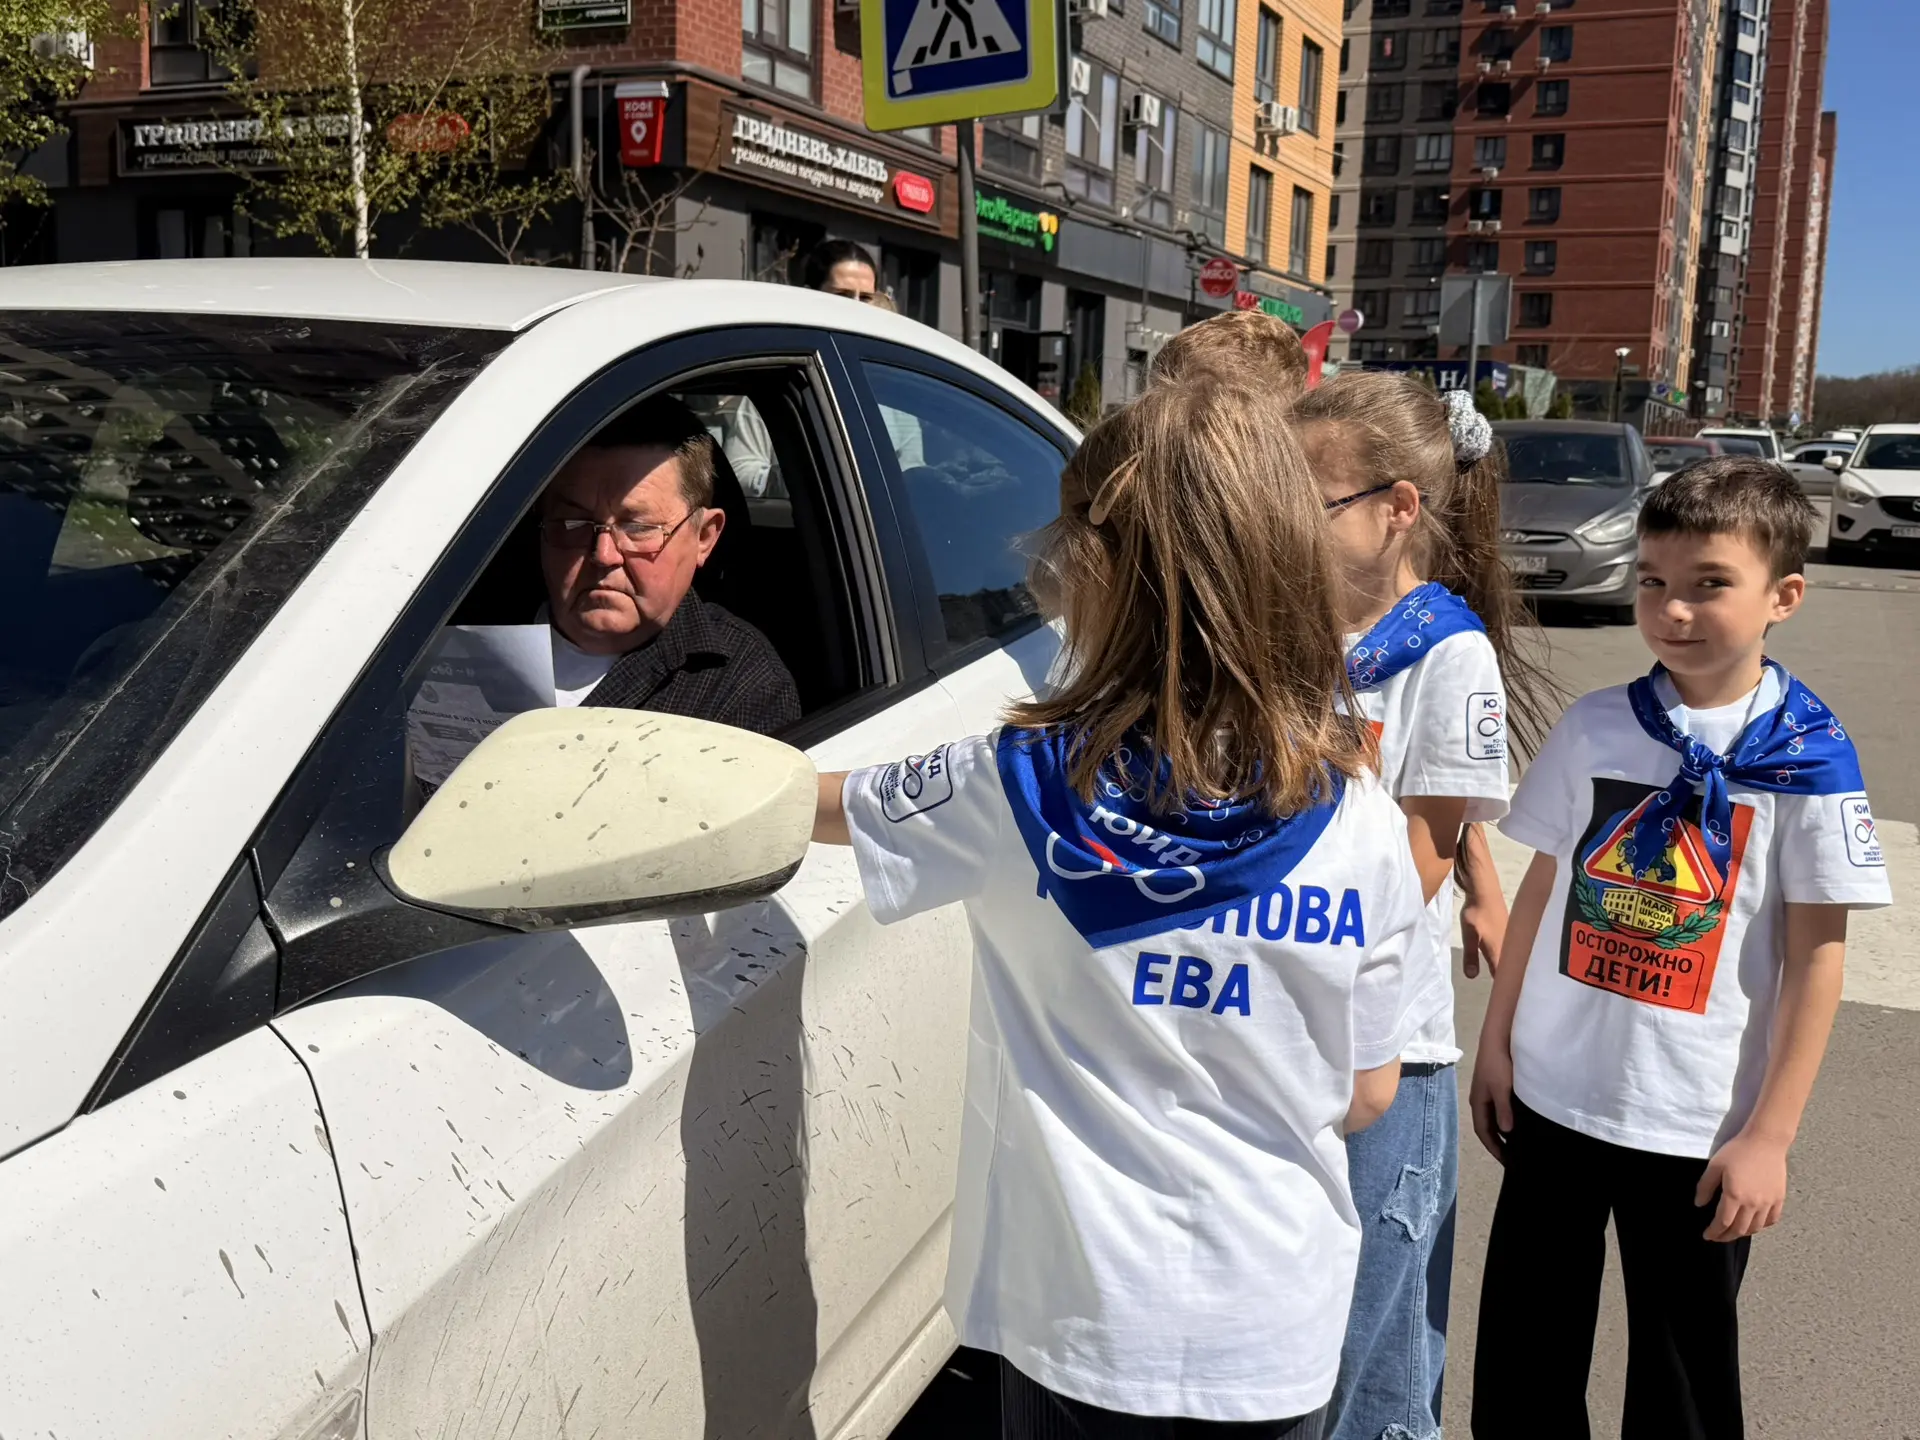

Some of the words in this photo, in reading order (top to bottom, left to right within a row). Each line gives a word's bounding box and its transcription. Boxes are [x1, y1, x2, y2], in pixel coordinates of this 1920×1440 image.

[624, 101, 654, 112] КОФЕ
[1640, 897, 1674, 915] МАОУ
[1640, 907, 1673, 923] ШКОЛА
[1576, 929, 1693, 974] ОСТОРОЖНО
[1132, 951, 1251, 1017] ЕВА
[1584, 954, 1673, 998] ДЕТИ!
